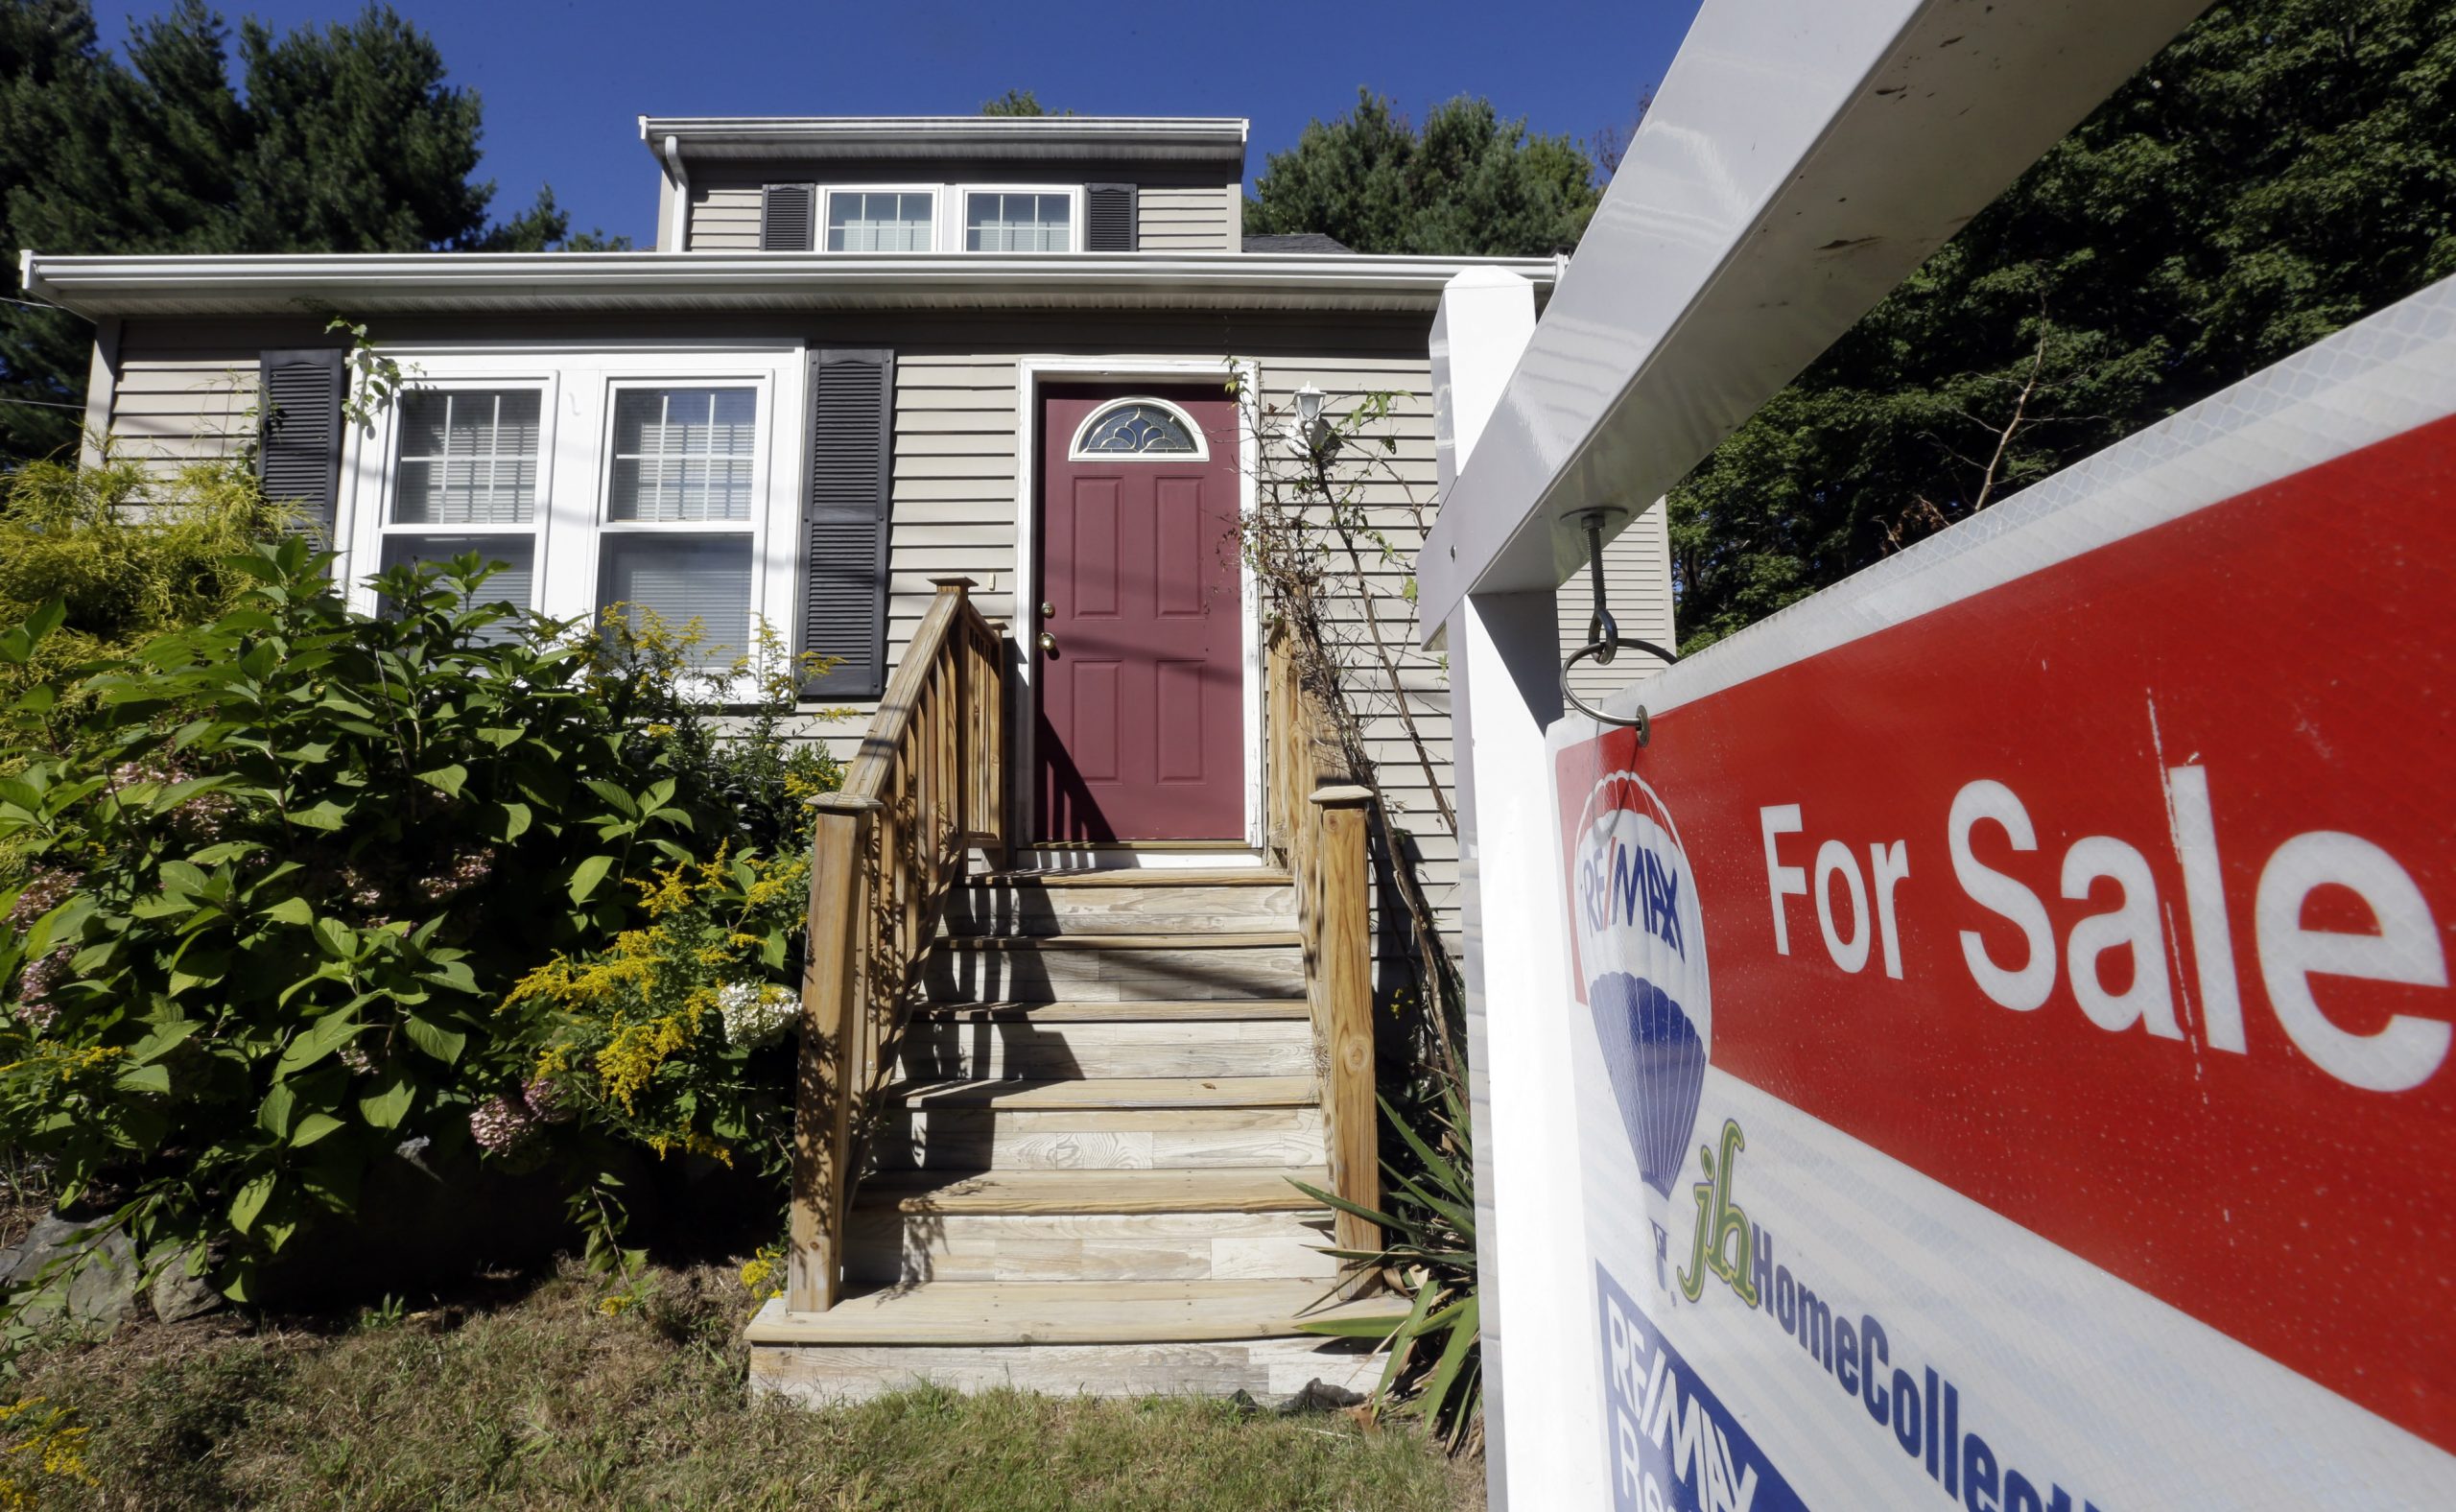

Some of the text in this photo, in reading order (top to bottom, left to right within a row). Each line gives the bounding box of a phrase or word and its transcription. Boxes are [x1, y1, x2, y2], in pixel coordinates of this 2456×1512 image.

[1583, 837, 1686, 964] RE/MAX
[1759, 765, 2453, 1093] For Sale
